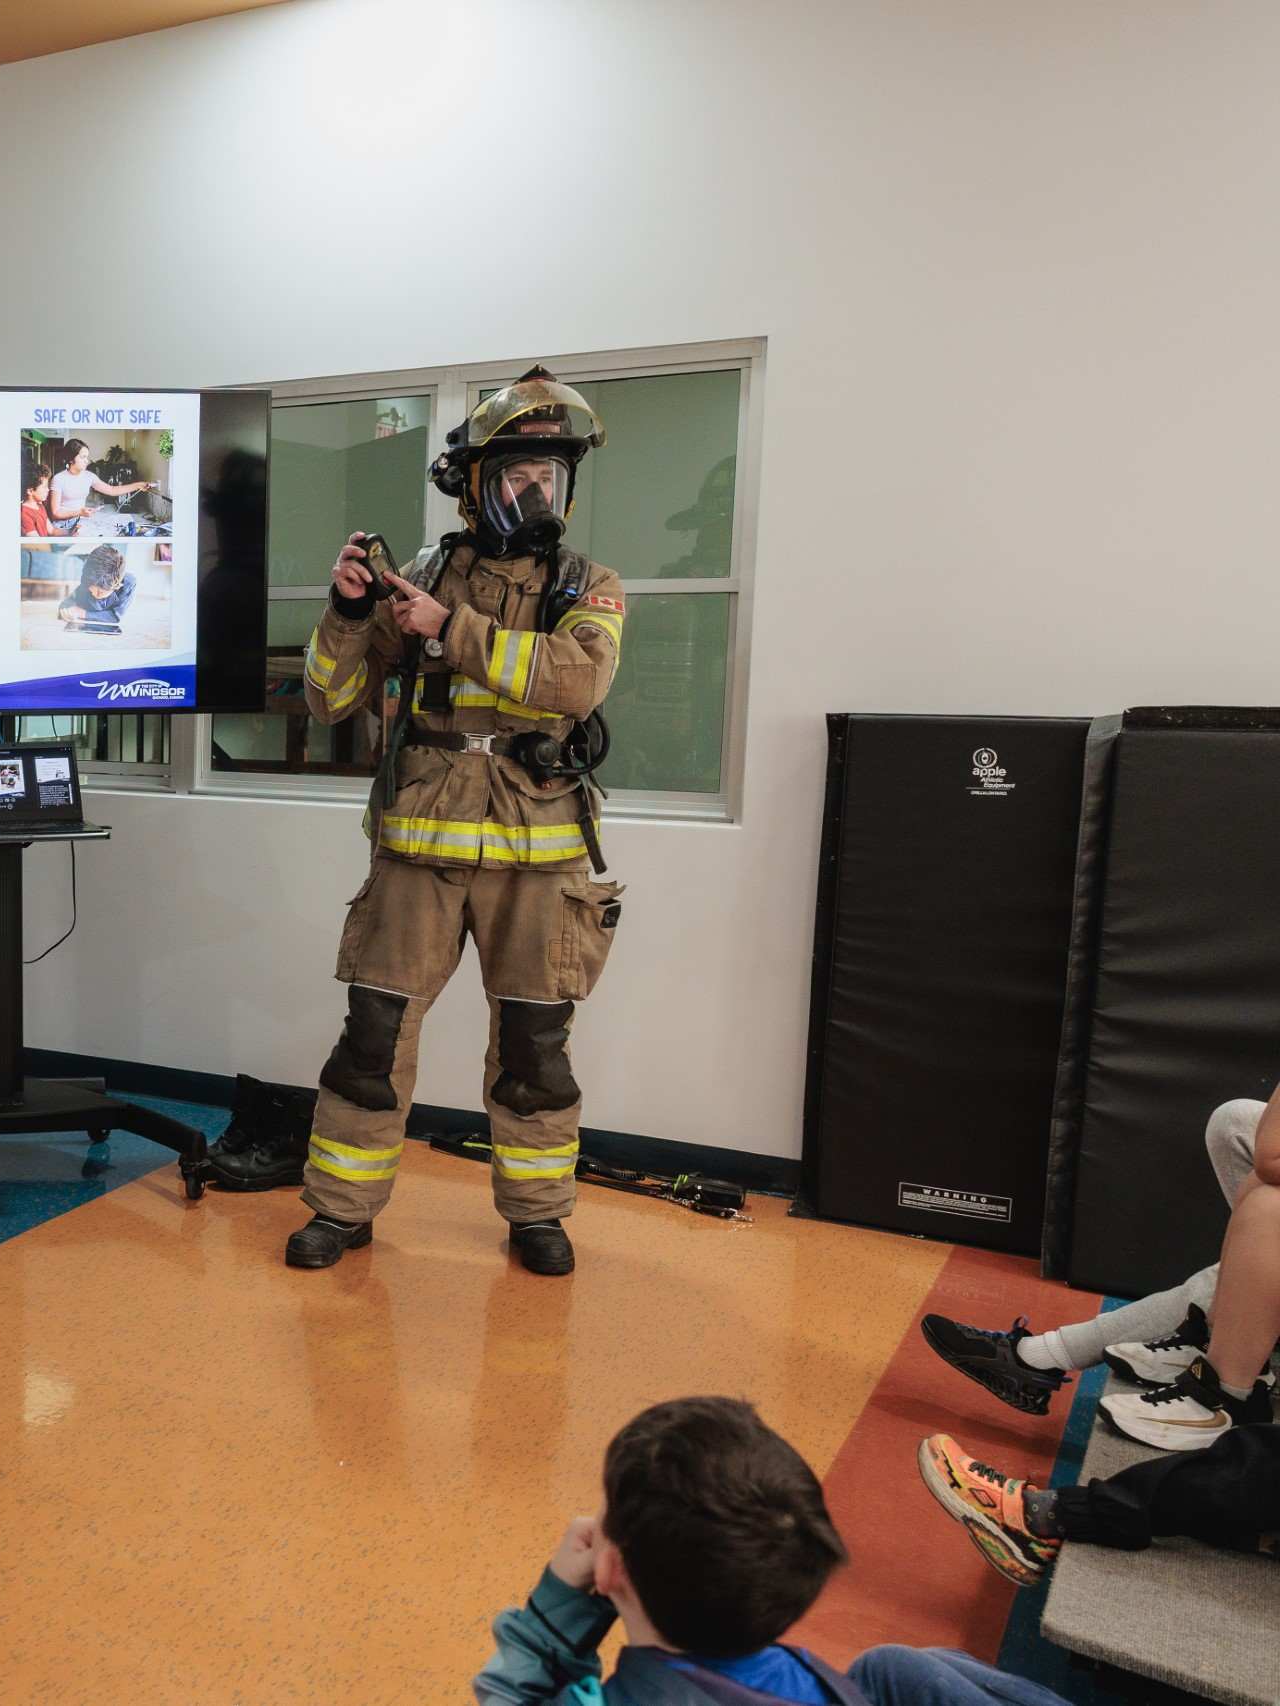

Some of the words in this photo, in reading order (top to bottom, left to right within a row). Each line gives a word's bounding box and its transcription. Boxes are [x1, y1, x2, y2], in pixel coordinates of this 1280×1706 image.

[34, 408, 66, 424] SAFE
[71, 408, 91, 424] OR
[95, 409, 124, 424] NOT
[129, 409, 161, 424] SAFE
[972, 766, 1007, 778] apple
[922, 1188, 987, 1204] WARNING
